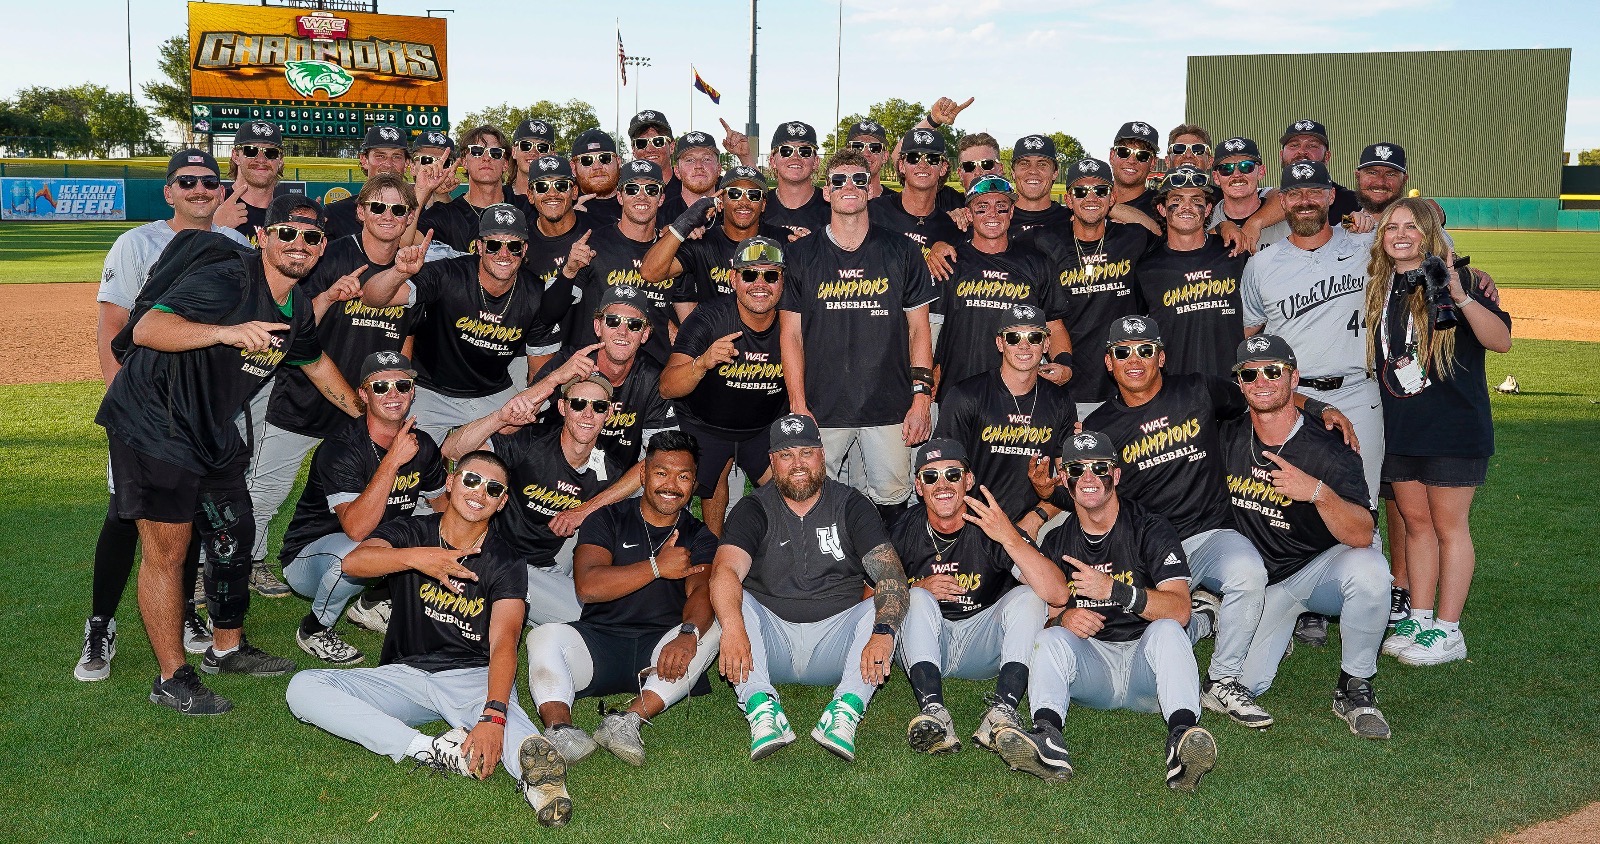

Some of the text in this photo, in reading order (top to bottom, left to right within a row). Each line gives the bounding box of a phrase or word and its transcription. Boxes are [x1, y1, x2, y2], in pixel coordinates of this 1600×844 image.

[300, 16, 346, 31] WAC
[198, 32, 439, 79] CHAMPIONS
[406, 114, 440, 126] 0 0 0
[60, 185, 117, 193] ICE COLD
[55, 200, 115, 214] BEER
[1082, 253, 1107, 264] WAC
[838, 269, 864, 278] WAC
[982, 270, 1009, 280] WAC
[1060, 258, 1130, 286] CHAPIONS
[1184, 270, 1212, 282] WAC
[818, 276, 888, 300] CHAMPIONS
[956, 279, 1030, 300] CHAMPIONS
[1071, 282, 1125, 295] BASEBALL
[1163, 277, 1236, 307] CHAMPIONS
[1276, 274, 1364, 320] Utah Valley
[826, 301, 880, 309] BASEBALL
[966, 300, 1012, 310] BASEBA
[1176, 300, 1230, 314] BASEBALL
[480, 310, 502, 324] WAC
[271, 335, 284, 348] AC
[460, 333, 509, 351] BASEBALL
[745, 352, 769, 362] WAC
[719, 362, 784, 381] CHAMPION
[726, 380, 778, 390] BASEBALL
[1008, 414, 1032, 424] WAC
[1140, 416, 1169, 434] WAC
[981, 424, 1053, 445] CHAMPIONS
[1122, 418, 1200, 464] CHAMPIONS
[991, 446, 1042, 456] BASEBALL
[1138, 445, 1198, 470] BASEBALL
[1188, 451, 1207, 462] 2025
[1251, 466, 1272, 482] WAC
[557, 480, 581, 495] WAC
[388, 495, 410, 505] BALL
[523, 484, 586, 510] CHAMPIO
[526, 501, 558, 516] BASE
[1270, 520, 1291, 530] 2025
[931, 562, 959, 574] WAC
